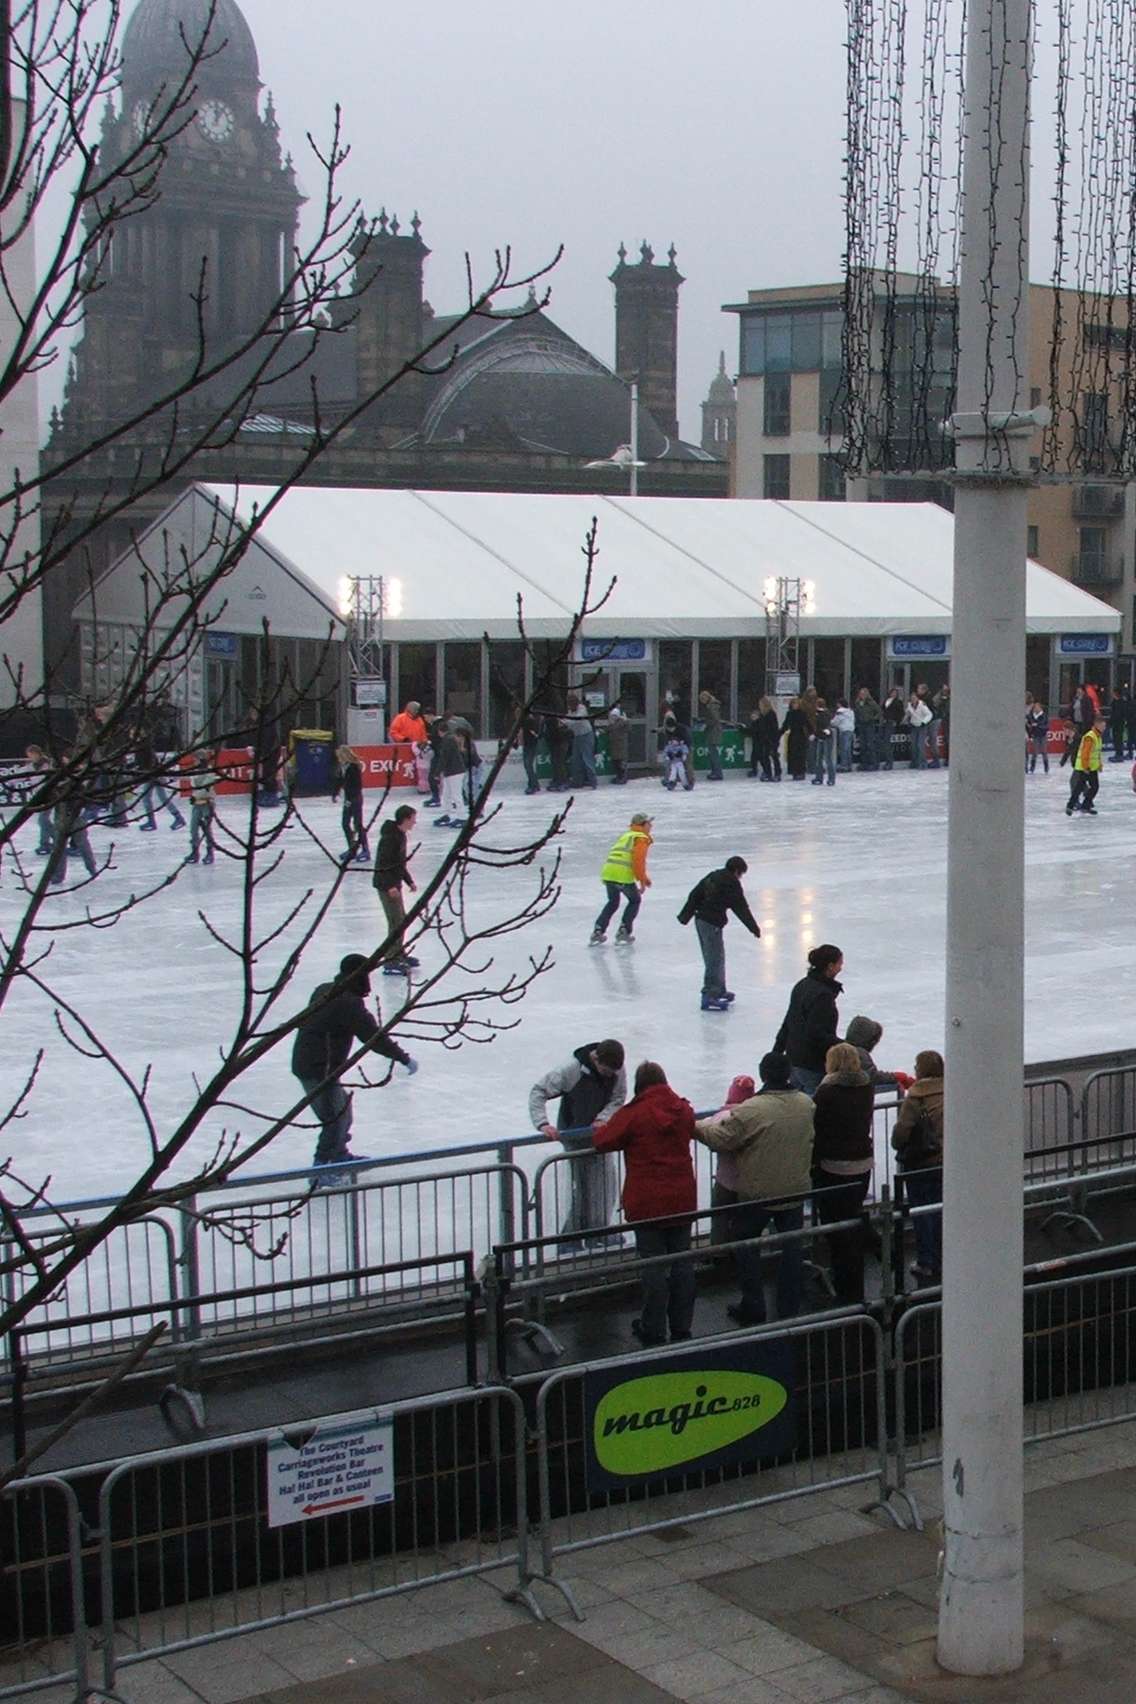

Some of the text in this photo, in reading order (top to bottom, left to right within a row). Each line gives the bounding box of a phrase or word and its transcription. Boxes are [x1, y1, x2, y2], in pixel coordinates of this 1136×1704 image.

[603, 1385, 761, 1437] magic 828
[299, 1435, 364, 1456] The Courtyard
[278, 1444, 384, 1472] Carriageworks Theatre
[298, 1458, 365, 1480] Revolution Bar
[317, 1476, 333, 1487] Bar
[335, 1474, 343, 1483] &
[346, 1466, 383, 1481] Canteen
[293, 1479, 371, 1505] all open as usual
